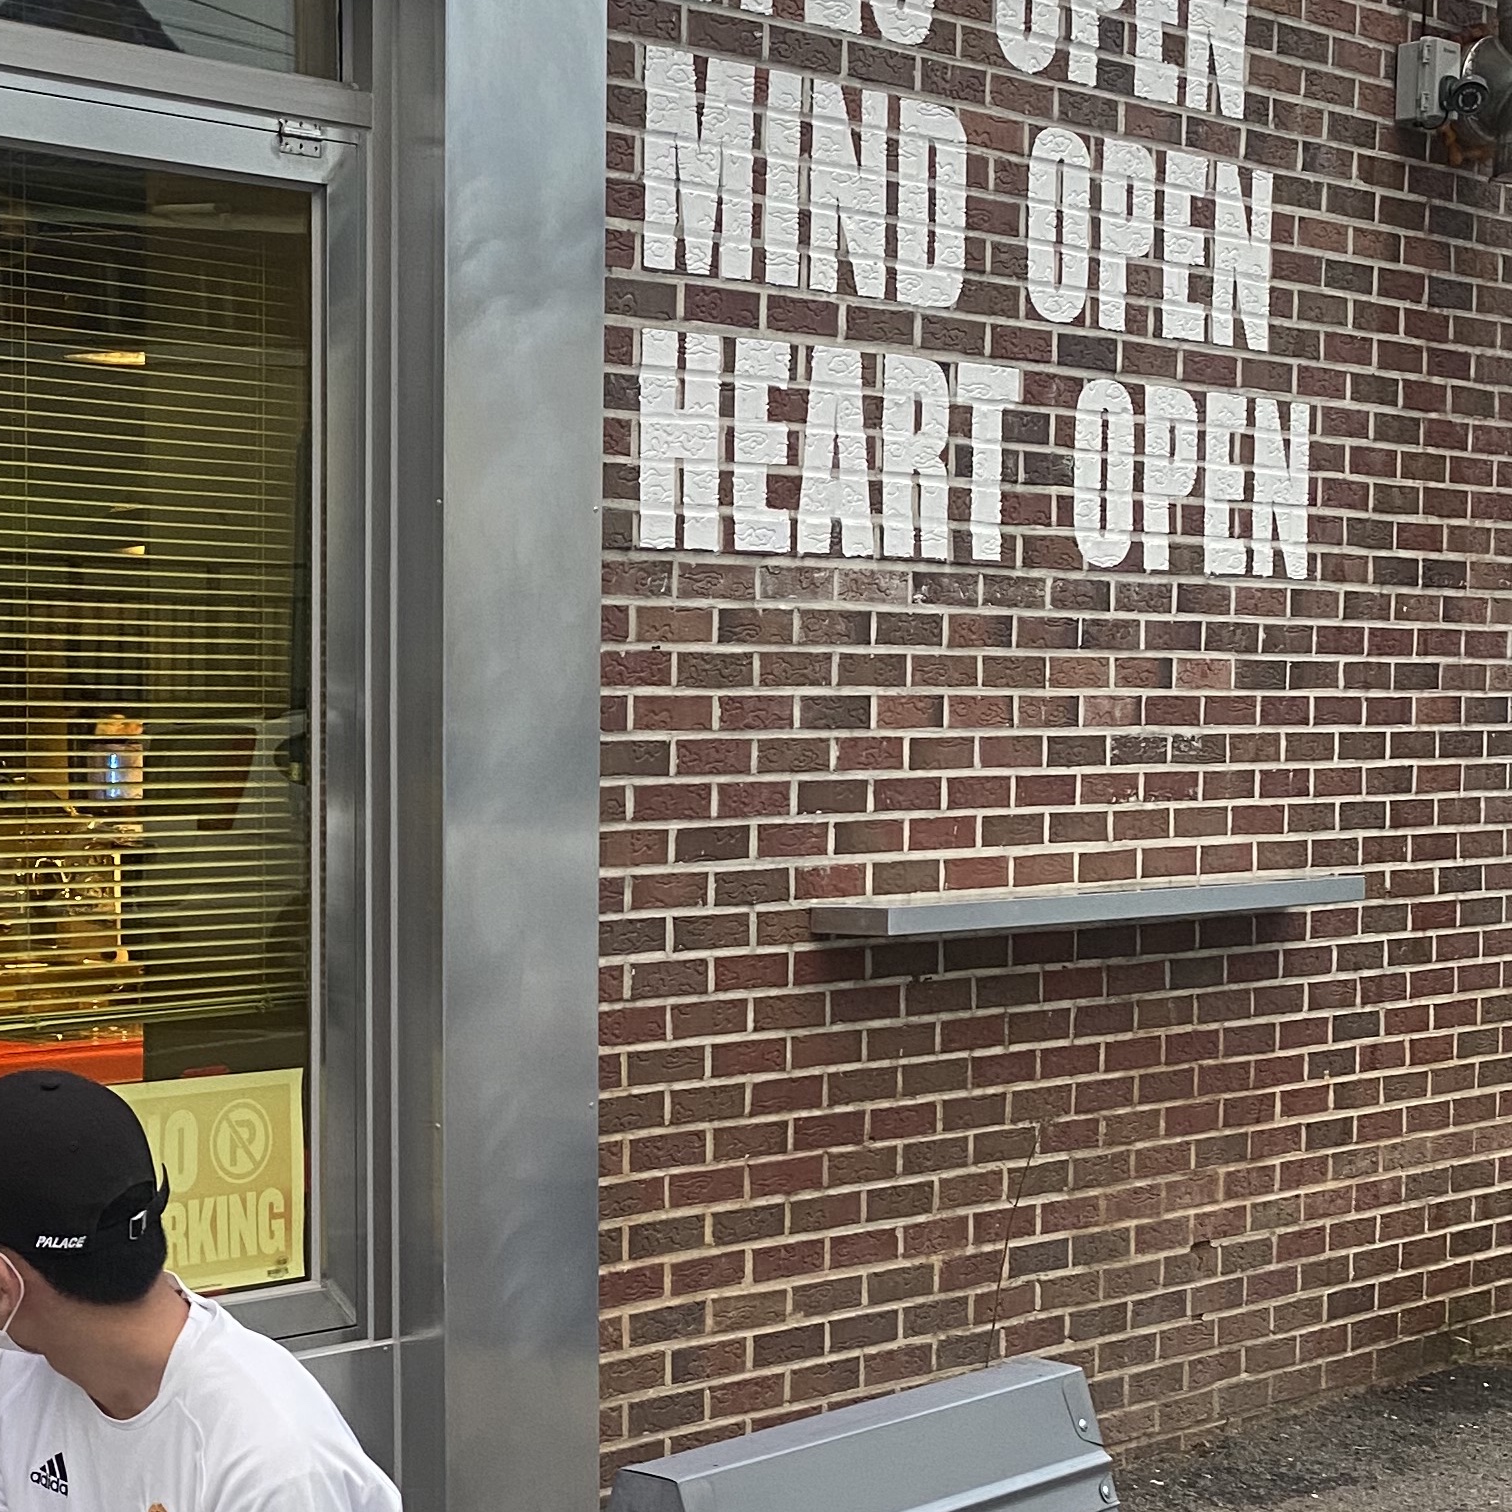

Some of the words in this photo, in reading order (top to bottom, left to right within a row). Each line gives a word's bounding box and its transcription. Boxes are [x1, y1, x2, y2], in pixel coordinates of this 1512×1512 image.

[643, 45, 968, 309] MIND
[1027, 126, 1274, 353] OPEN
[638, 327, 1023, 563] HEART
[1075, 378, 1311, 581] OPEN
[35, 1235, 87, 1249] PALACE
[161, 1187, 286, 1270] RKING
